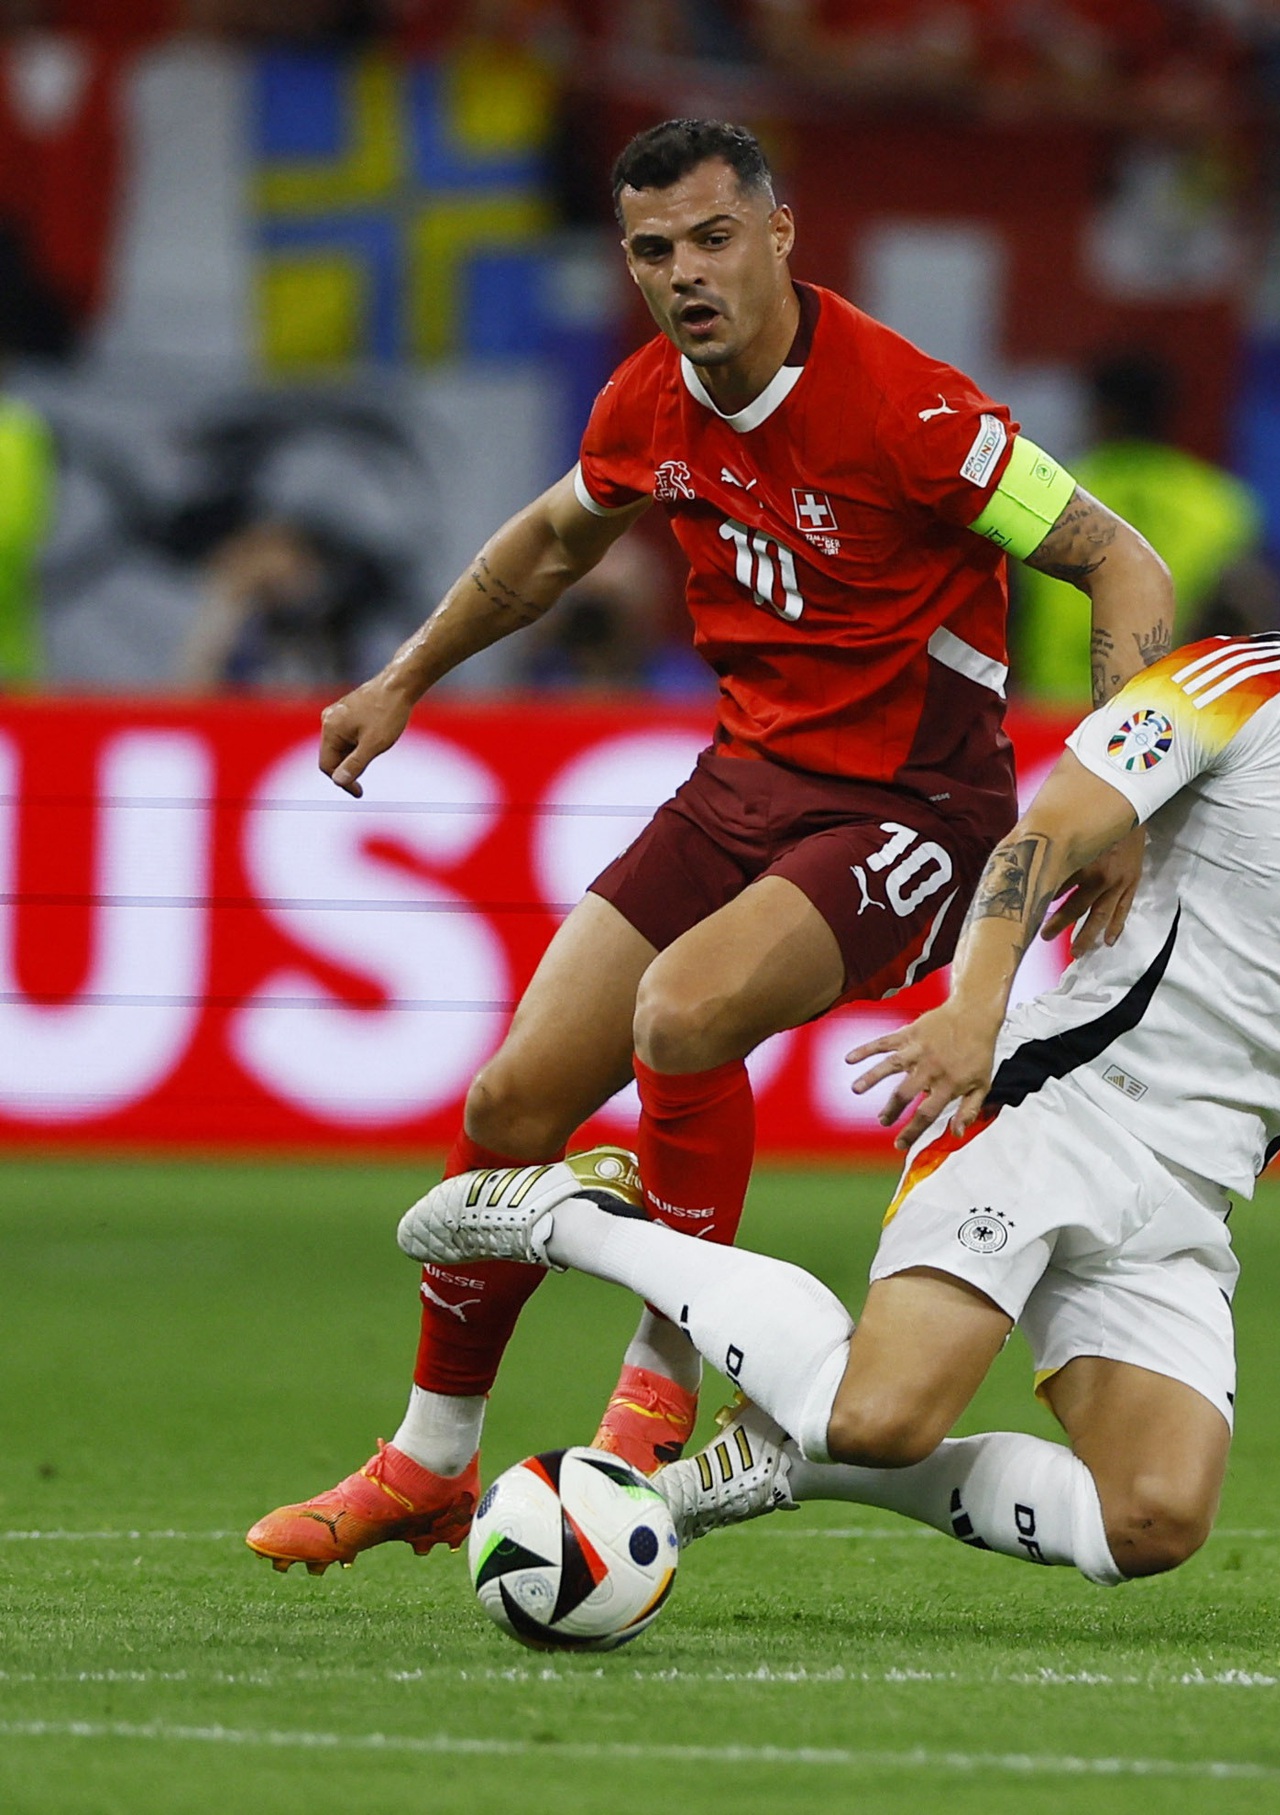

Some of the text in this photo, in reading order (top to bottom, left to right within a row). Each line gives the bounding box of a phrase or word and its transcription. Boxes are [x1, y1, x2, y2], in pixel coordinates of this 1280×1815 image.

[719, 518, 804, 621] 10
[866, 822, 953, 917] 10
[647, 1190, 716, 1219] SUISSE
[423, 1262, 486, 1290] UISSE
